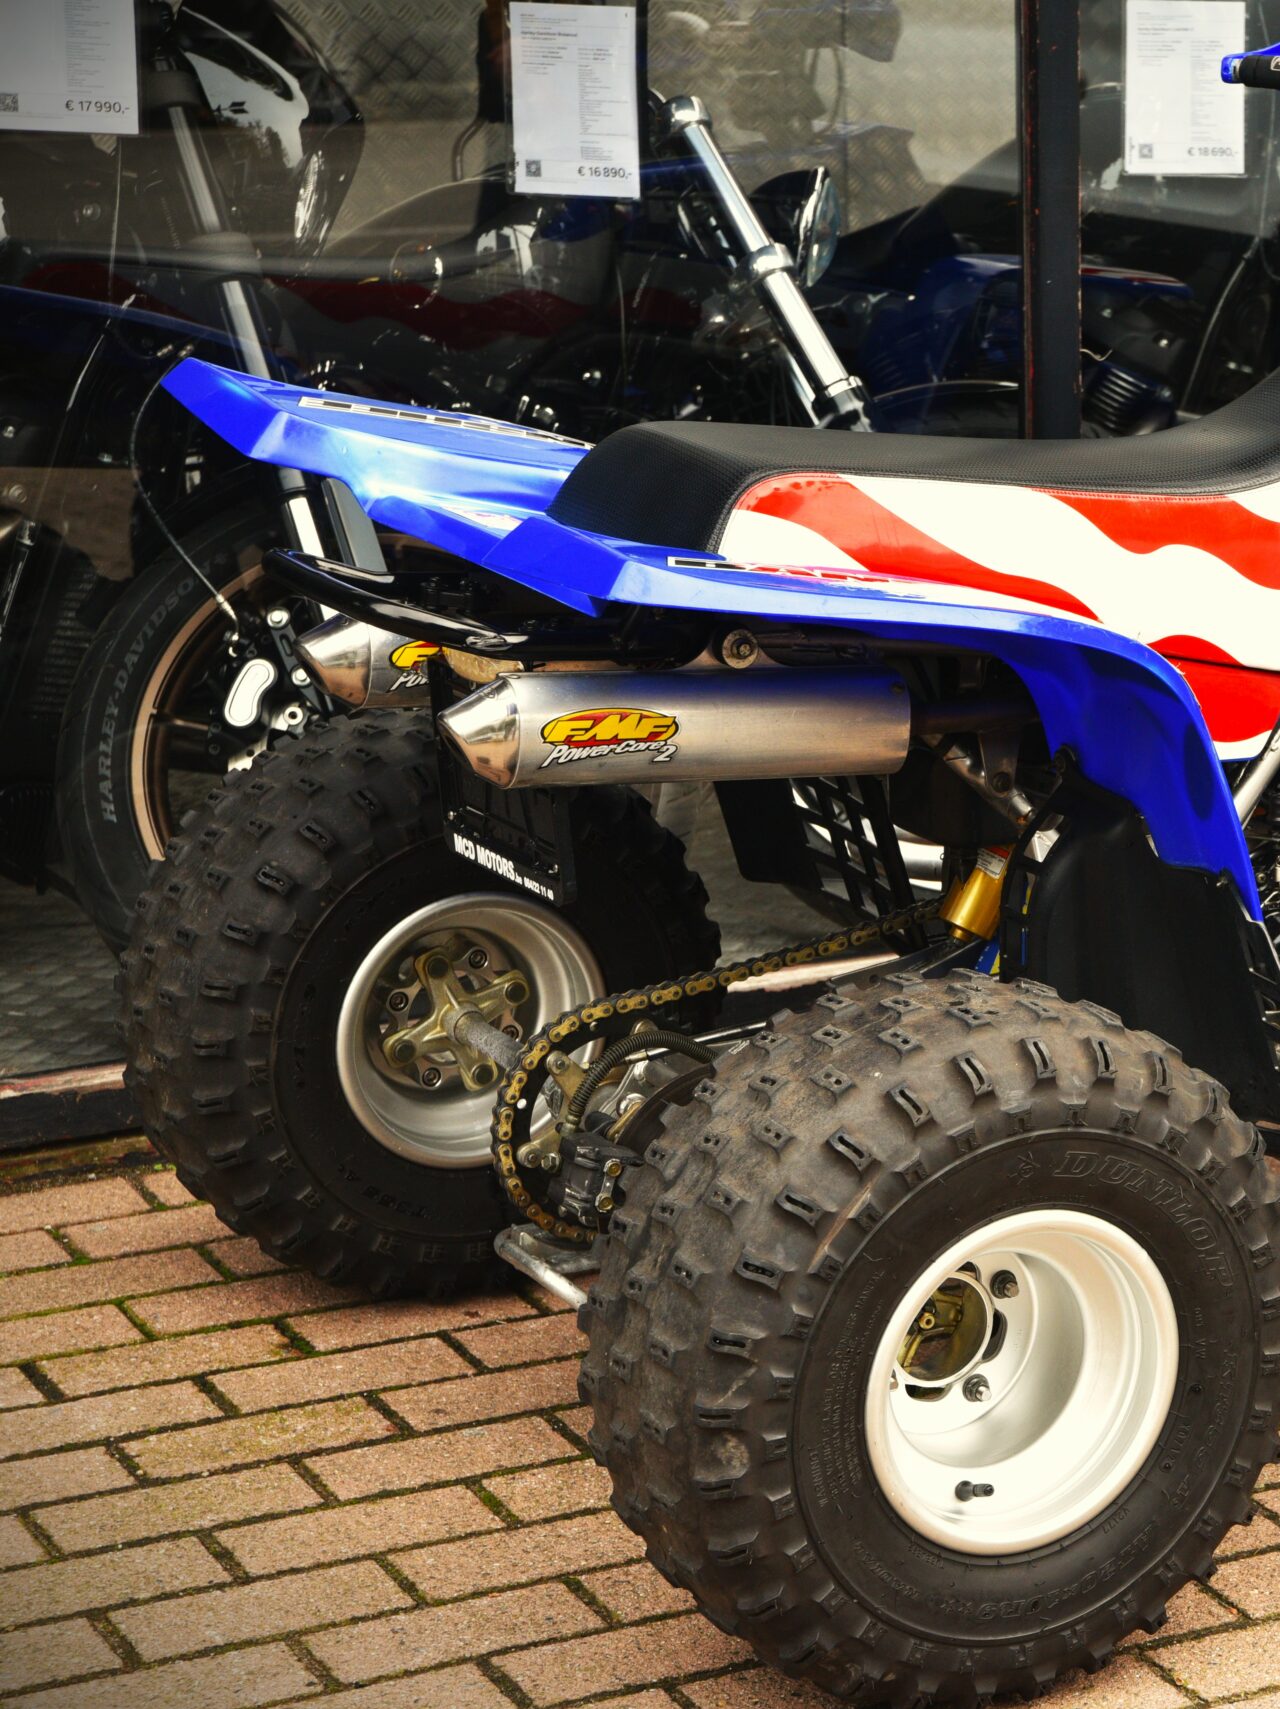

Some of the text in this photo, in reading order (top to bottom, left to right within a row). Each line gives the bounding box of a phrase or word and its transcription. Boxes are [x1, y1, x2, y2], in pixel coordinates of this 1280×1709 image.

[65, 100, 74, 111] €
[1187, 147, 1196, 157] €
[577, 166, 585, 176] €
[543, 713, 677, 744] FMF
[652, 744, 678, 763] 2
[453, 832, 476, 861] MCD
[1052, 1149, 1234, 1289] DUNLOP
